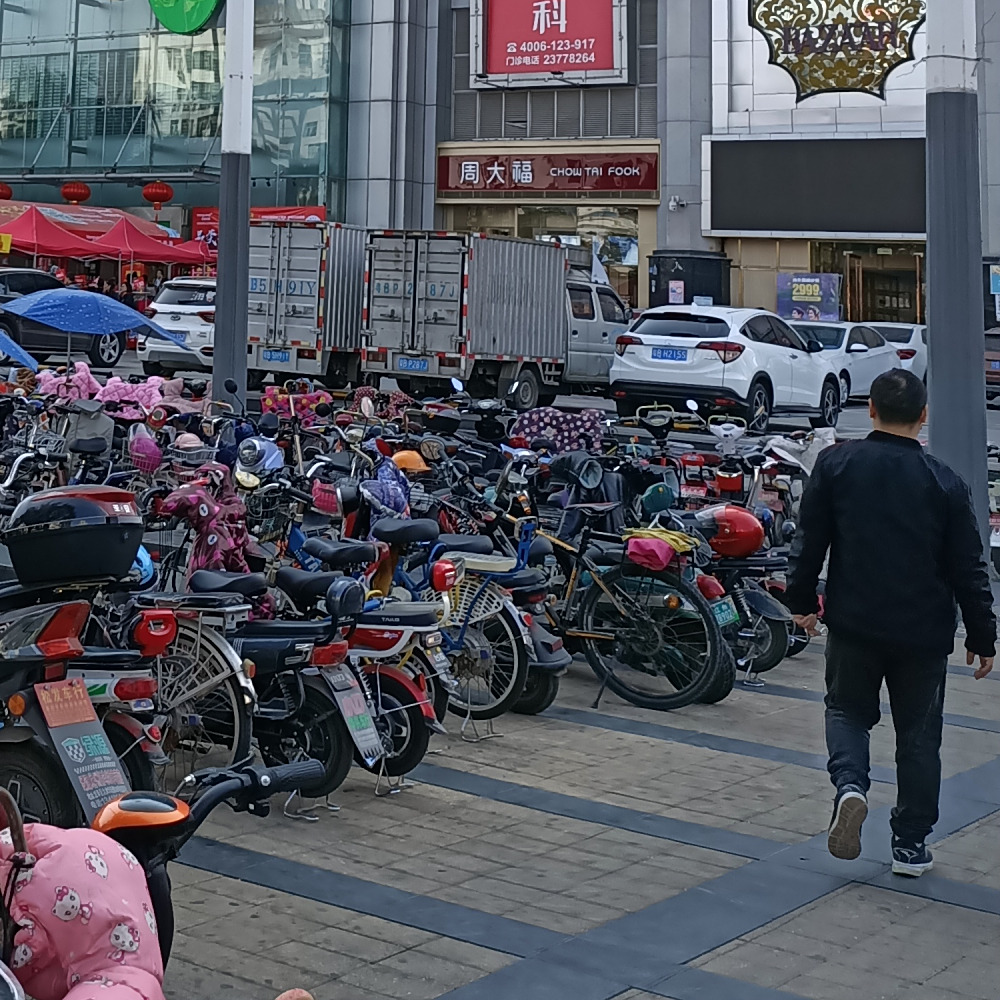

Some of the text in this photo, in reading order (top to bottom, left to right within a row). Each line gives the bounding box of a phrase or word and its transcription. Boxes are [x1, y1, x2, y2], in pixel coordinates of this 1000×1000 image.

[520, 38, 595, 52] 4006-123-917
[780, 21, 900, 55] BAZAAR
[506, 53, 595, 66] 门诊电话 23778264
[460, 160, 640, 184] 周大福 CHOW TAI FOOK
[792, 284, 819, 296] 2999
